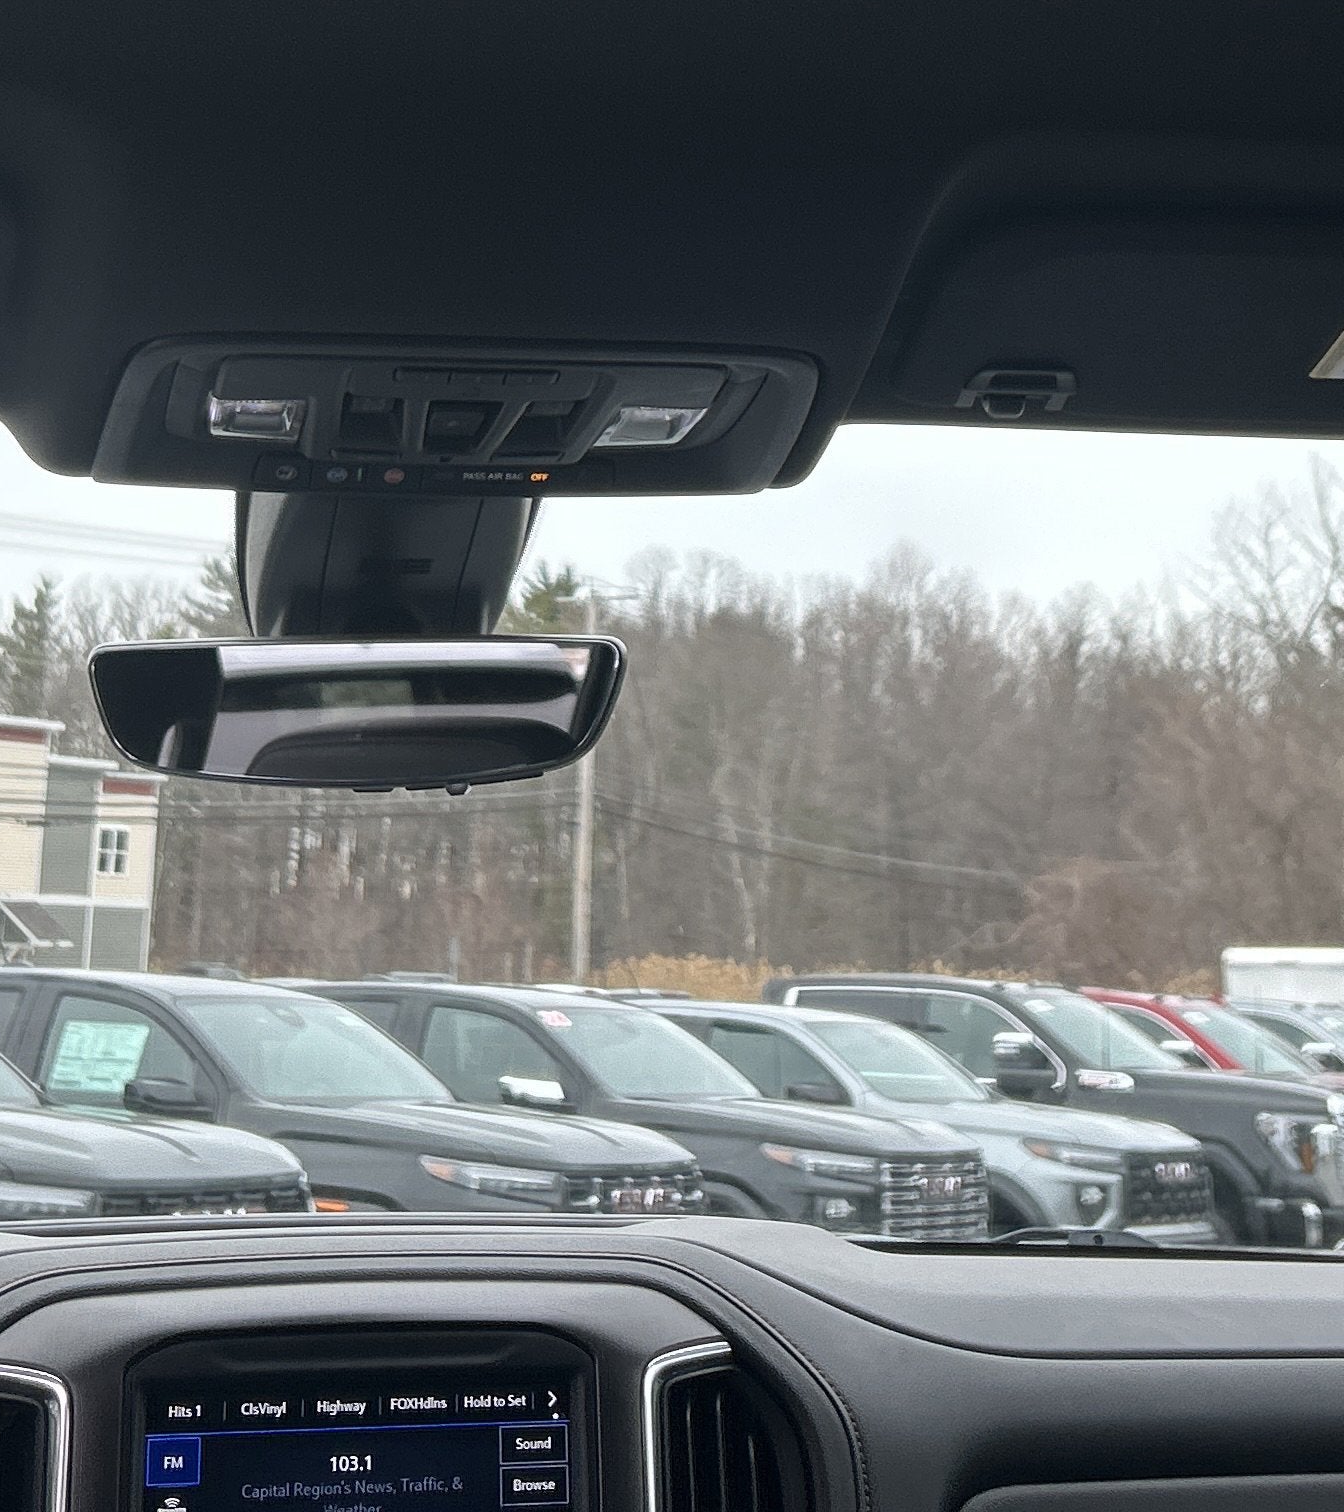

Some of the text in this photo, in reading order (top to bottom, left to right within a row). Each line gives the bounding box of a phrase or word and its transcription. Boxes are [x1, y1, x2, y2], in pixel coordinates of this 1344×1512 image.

[487, 472, 504, 481] AIR
[530, 471, 550, 482] OFF
[317, 1400, 366, 1416] Highway
[390, 1396, 448, 1411] FOXHdlns
[463, 1394, 527, 1409] Hold to Set
[168, 1404, 202, 1419] Hits 1
[240, 1401, 287, 1418] ClsVinyl
[515, 1436, 552, 1450] Sound
[163, 1456, 184, 1470] FM
[330, 1455, 373, 1472] 103.1
[241, 1476, 464, 1501] Capital Region's News, Traffic, &
[513, 1478, 556, 1492] Browse
